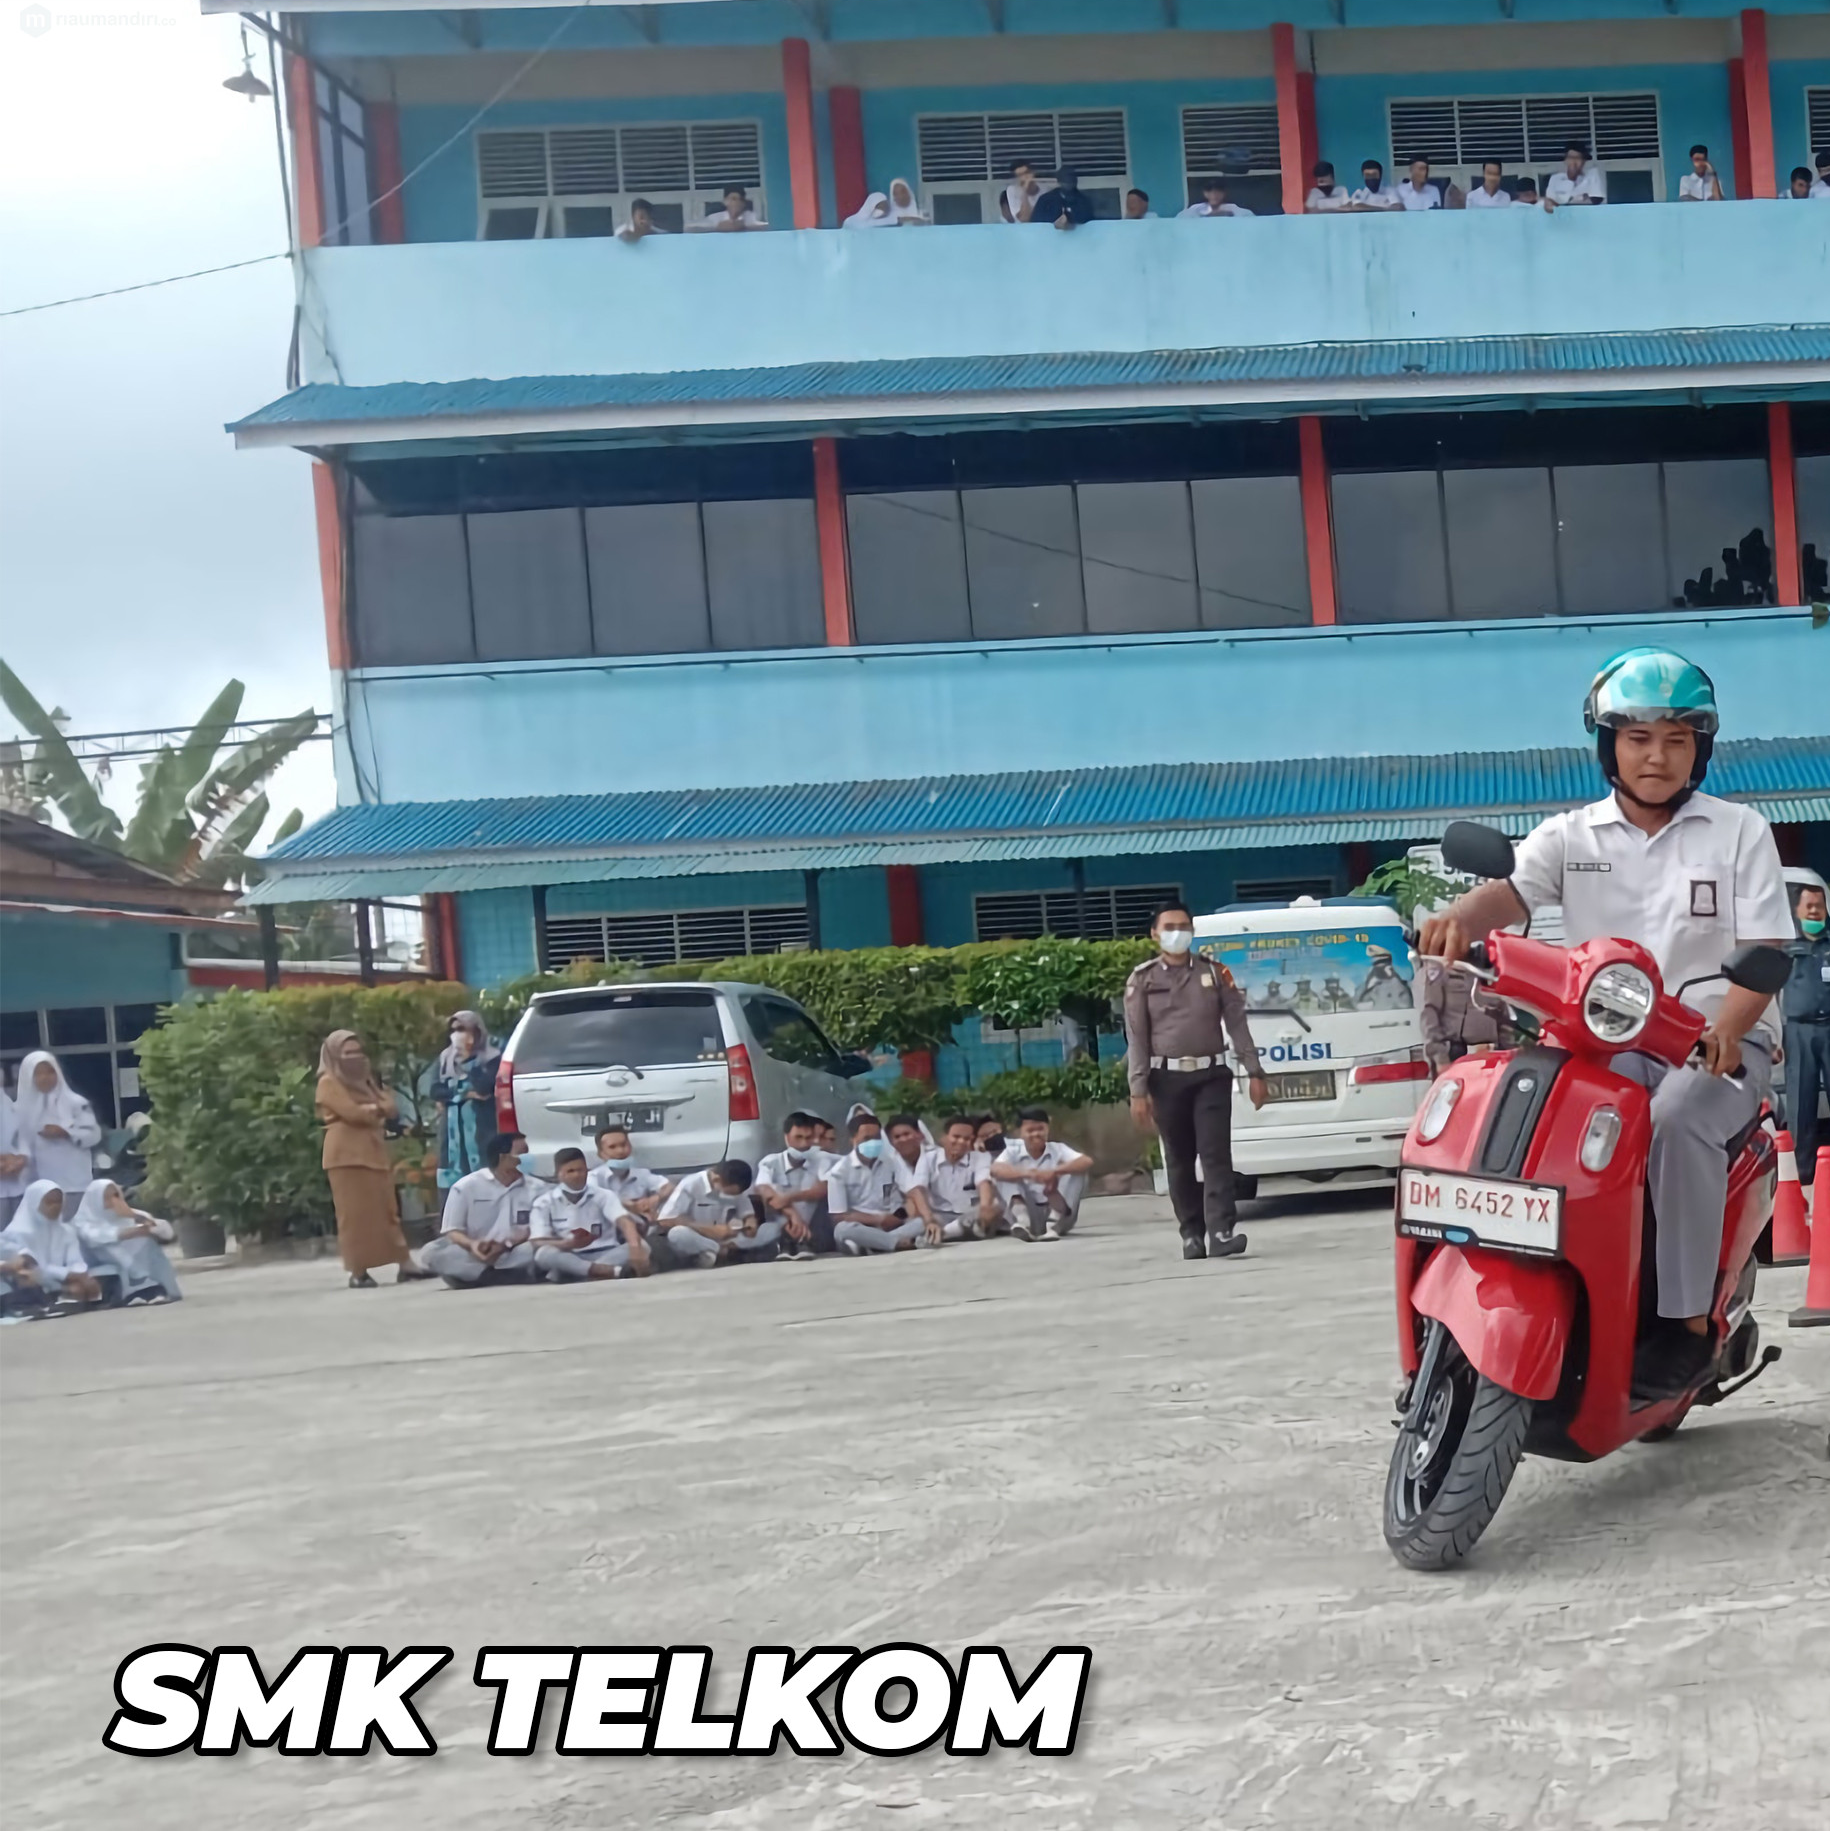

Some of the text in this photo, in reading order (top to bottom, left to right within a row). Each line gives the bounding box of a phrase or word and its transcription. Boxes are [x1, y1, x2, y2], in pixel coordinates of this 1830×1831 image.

[1257, 1042, 1332, 1062] POLISI
[1455, 1187, 1514, 1219] 6452
[1524, 1196, 1551, 1224] YX
